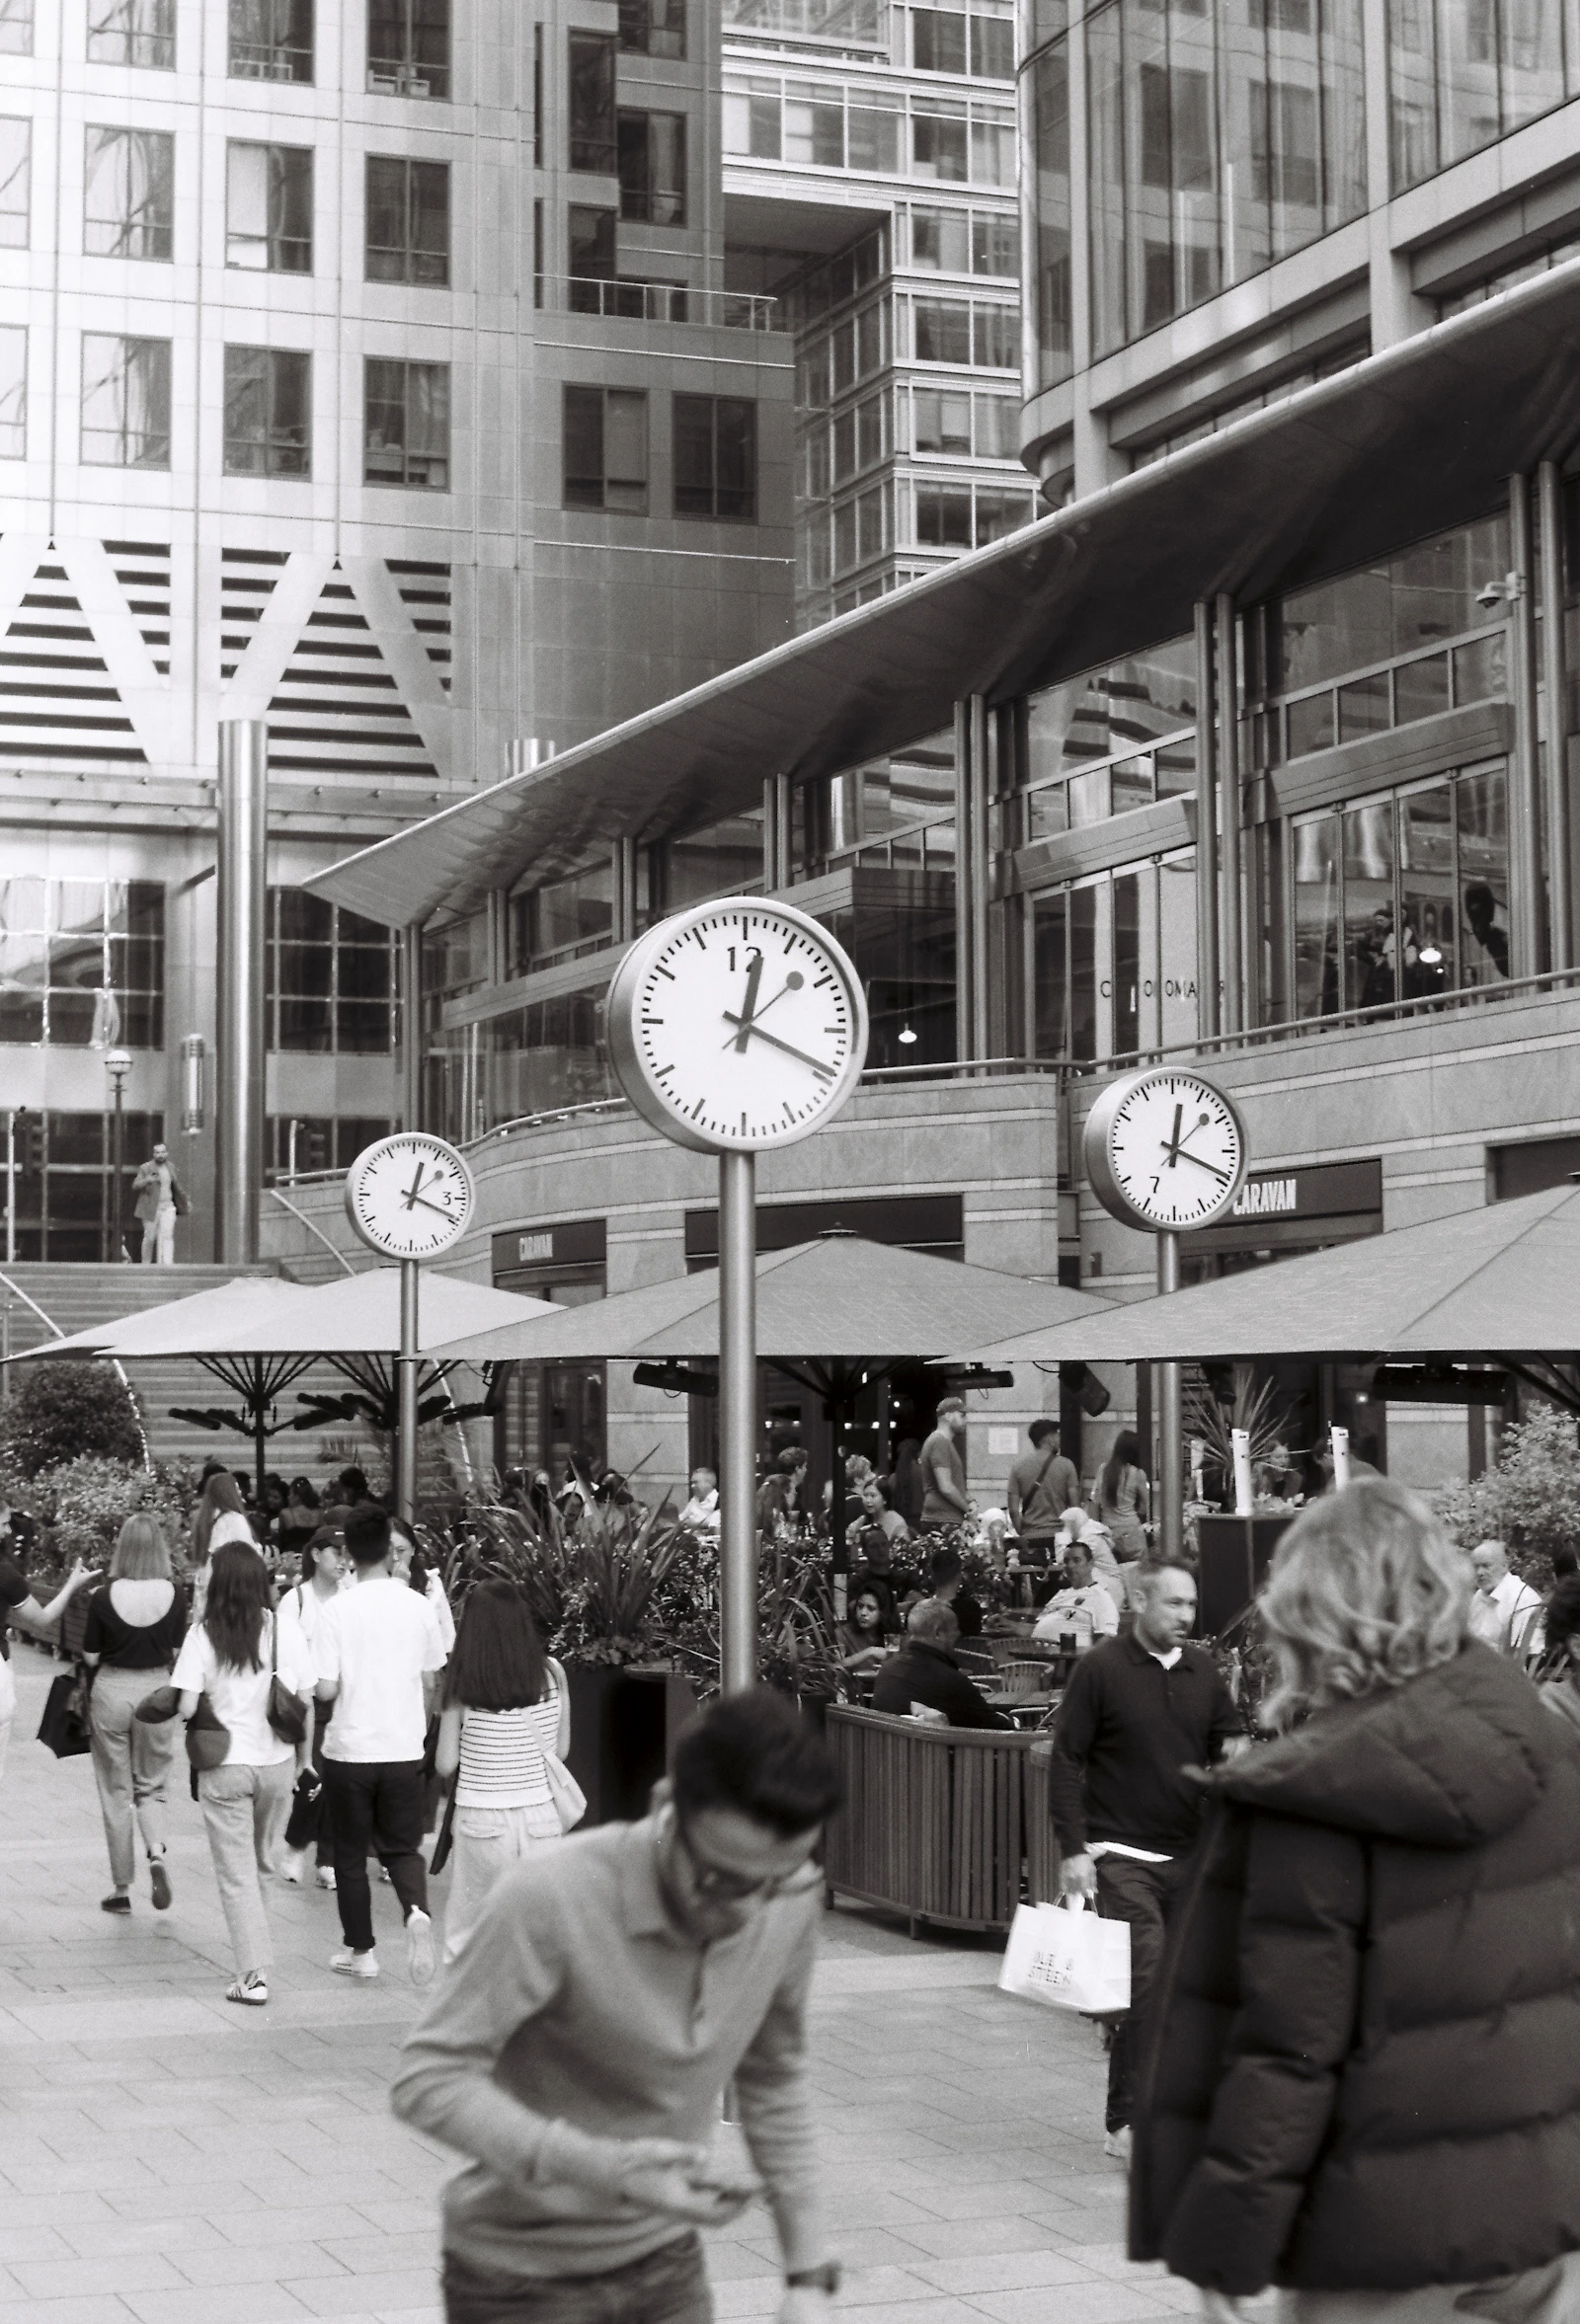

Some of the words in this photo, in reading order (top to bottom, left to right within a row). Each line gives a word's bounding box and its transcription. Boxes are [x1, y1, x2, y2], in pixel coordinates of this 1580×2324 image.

[727, 947, 761, 972] 12
[1149, 1176, 1160, 1194] 7
[442, 1192, 451, 1205] 3
